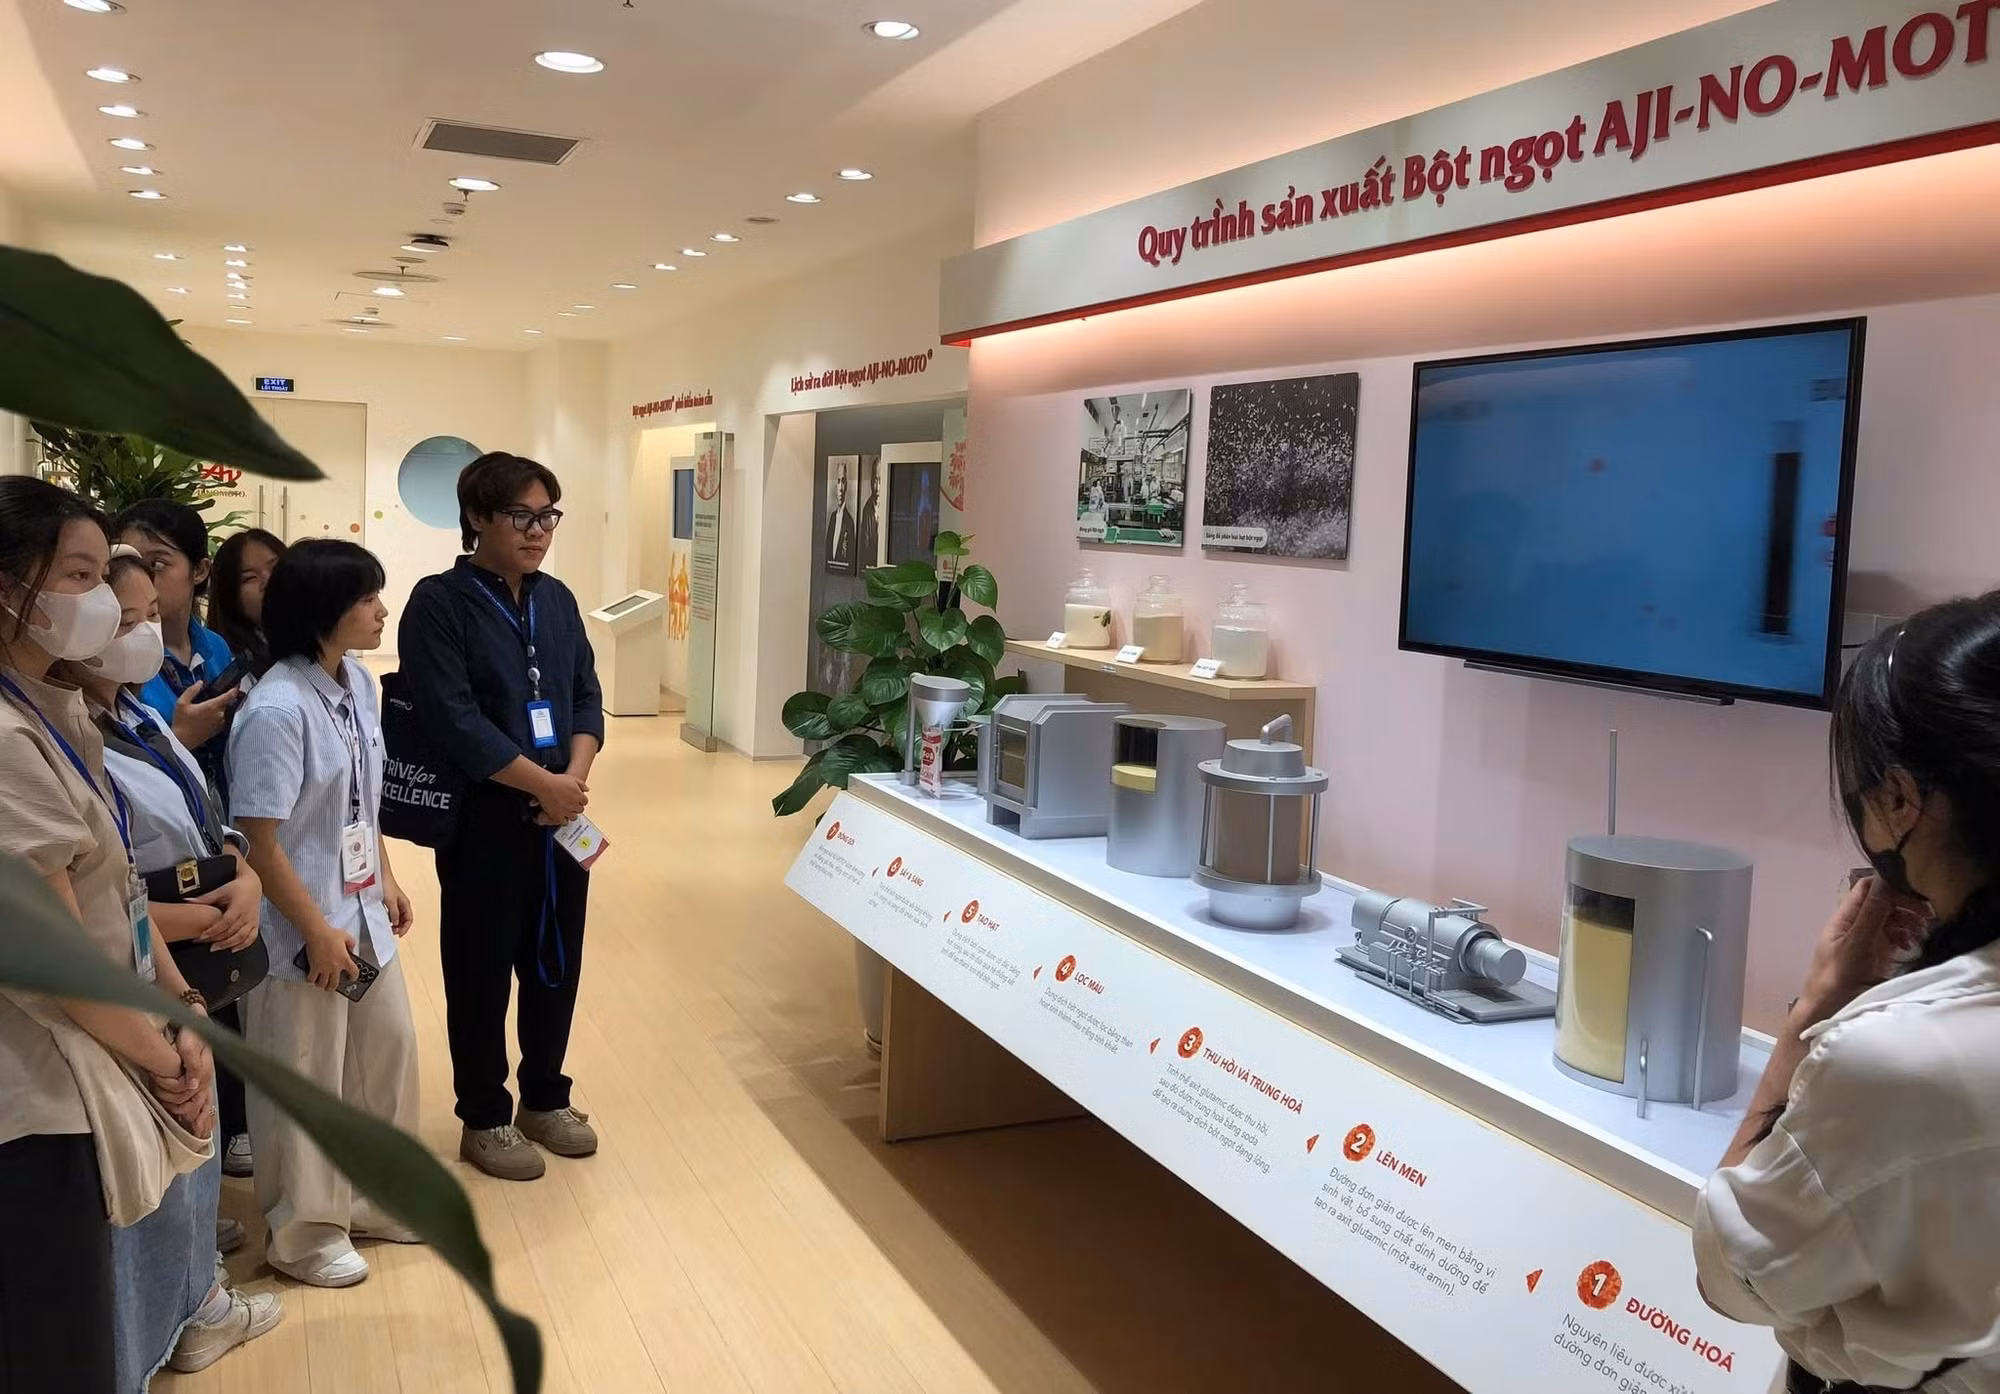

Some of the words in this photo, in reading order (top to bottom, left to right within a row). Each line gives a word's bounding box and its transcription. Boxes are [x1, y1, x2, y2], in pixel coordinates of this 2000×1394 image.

[1138, 225, 1187, 266] Quy
[1191, 198, 1255, 248] trình
[1261, 185, 1314, 234] sản
[1320, 155, 1395, 221] xuất
[1402, 145, 1472, 207] Bột
[1479, 115, 1586, 191] ngọt
[791, 376, 804, 395] Lịch
[814, 377, 821, 389] ra
[835, 369, 847, 390] Bột
[848, 366, 866, 387] ngọt
[382, 757, 416, 781] TRIVE
[408, 765, 437, 788] for
[382, 780, 452, 810] XCELLENCE
[829, 826, 836, 837] 7
[890, 861, 899, 873] 6
[965, 905, 975, 918] 5
[977, 914, 989, 926] TẠO
[987, 920, 1000, 932] HẠT
[1060, 962, 1071, 976] 4
[1074, 972, 1089, 985] LỌC
[1087, 979, 1105, 994] MÀU
[1166, 1063, 1179, 1078] Tinh
[1179, 1073, 1191, 1084] thể
[1189, 1081, 1201, 1091] axit
[1199, 1088, 1227, 1108] glutamic
[1227, 1104, 1244, 1119] được
[1244, 1114, 1256, 1127] thu
[1183, 1035, 1196, 1051] 3
[1203, 1048, 1221, 1064] THU
[1220, 1058, 1238, 1075] HỒI
[1237, 1067, 1250, 1082] VÀ
[1250, 1075, 1281, 1100] TRUNG
[1152, 1088, 1163, 1098] để
[1161, 1094, 1171, 1105] tạo
[1170, 1102, 1178, 1110] ra
[1177, 1106, 1194, 1122] dung
[1193, 1116, 1208, 1130] dịch
[1207, 1124, 1220, 1138] bột
[1219, 1135, 1236, 1149] ngọt
[1235, 1144, 1253, 1163] dạng
[1159, 1078, 1170, 1088] sau
[1169, 1083, 1180, 1094] đó
[1178, 1089, 1194, 1104] được
[1194, 1100, 1211, 1117] trung
[1241, 1131, 1258, 1146] soda
[1350, 1132, 1367, 1153] 2
[1375, 1150, 1399, 1171] LÊN
[1398, 1163, 1427, 1187] MEN
[1314, 1196, 1327, 1210] tạo
[1327, 1207, 1336, 1216] ra
[1337, 1213, 1352, 1226] axit
[1351, 1223, 1388, 1250] glutamic
[1387, 1244, 1409, 1264] (một
[1409, 1261, 1427, 1276] axit
[1322, 1183, 1338, 1198] sinh
[1341, 1195, 1353, 1210] vật,
[1356, 1202, 1371, 1217] bổ
[1370, 1215, 1391, 1235] sung
[1393, 1229, 1413, 1246] chất
[1415, 1242, 1435, 1261] dinh
[1438, 1258, 1469, 1286] dưỡng
[1472, 1280, 1489, 1294] để
[1330, 1167, 1357, 1193] Đường
[1358, 1186, 1374, 1202] đơn
[1374, 1199, 1394, 1214] giản
[1396, 1210, 1419, 1230] được
[1419, 1223, 1434, 1240] lên
[1436, 1237, 1457, 1254] men
[1459, 1247, 1484, 1273] bằng
[1486, 1267, 1497, 1278] vi
[1563, 1314, 1607, 1350] Nguyên
[1610, 1343, 1632, 1366] liệu
[1634, 1362, 1667, 1388] được
[1593, 1273, 1608, 1297] 1
[1625, 1297, 1691, 1346] ĐƯỜNG
[1692, 1337, 1736, 1373] HOÁ
[1554, 1334, 1591, 1366] đường
[1594, 1360, 1617, 1380] đơn
